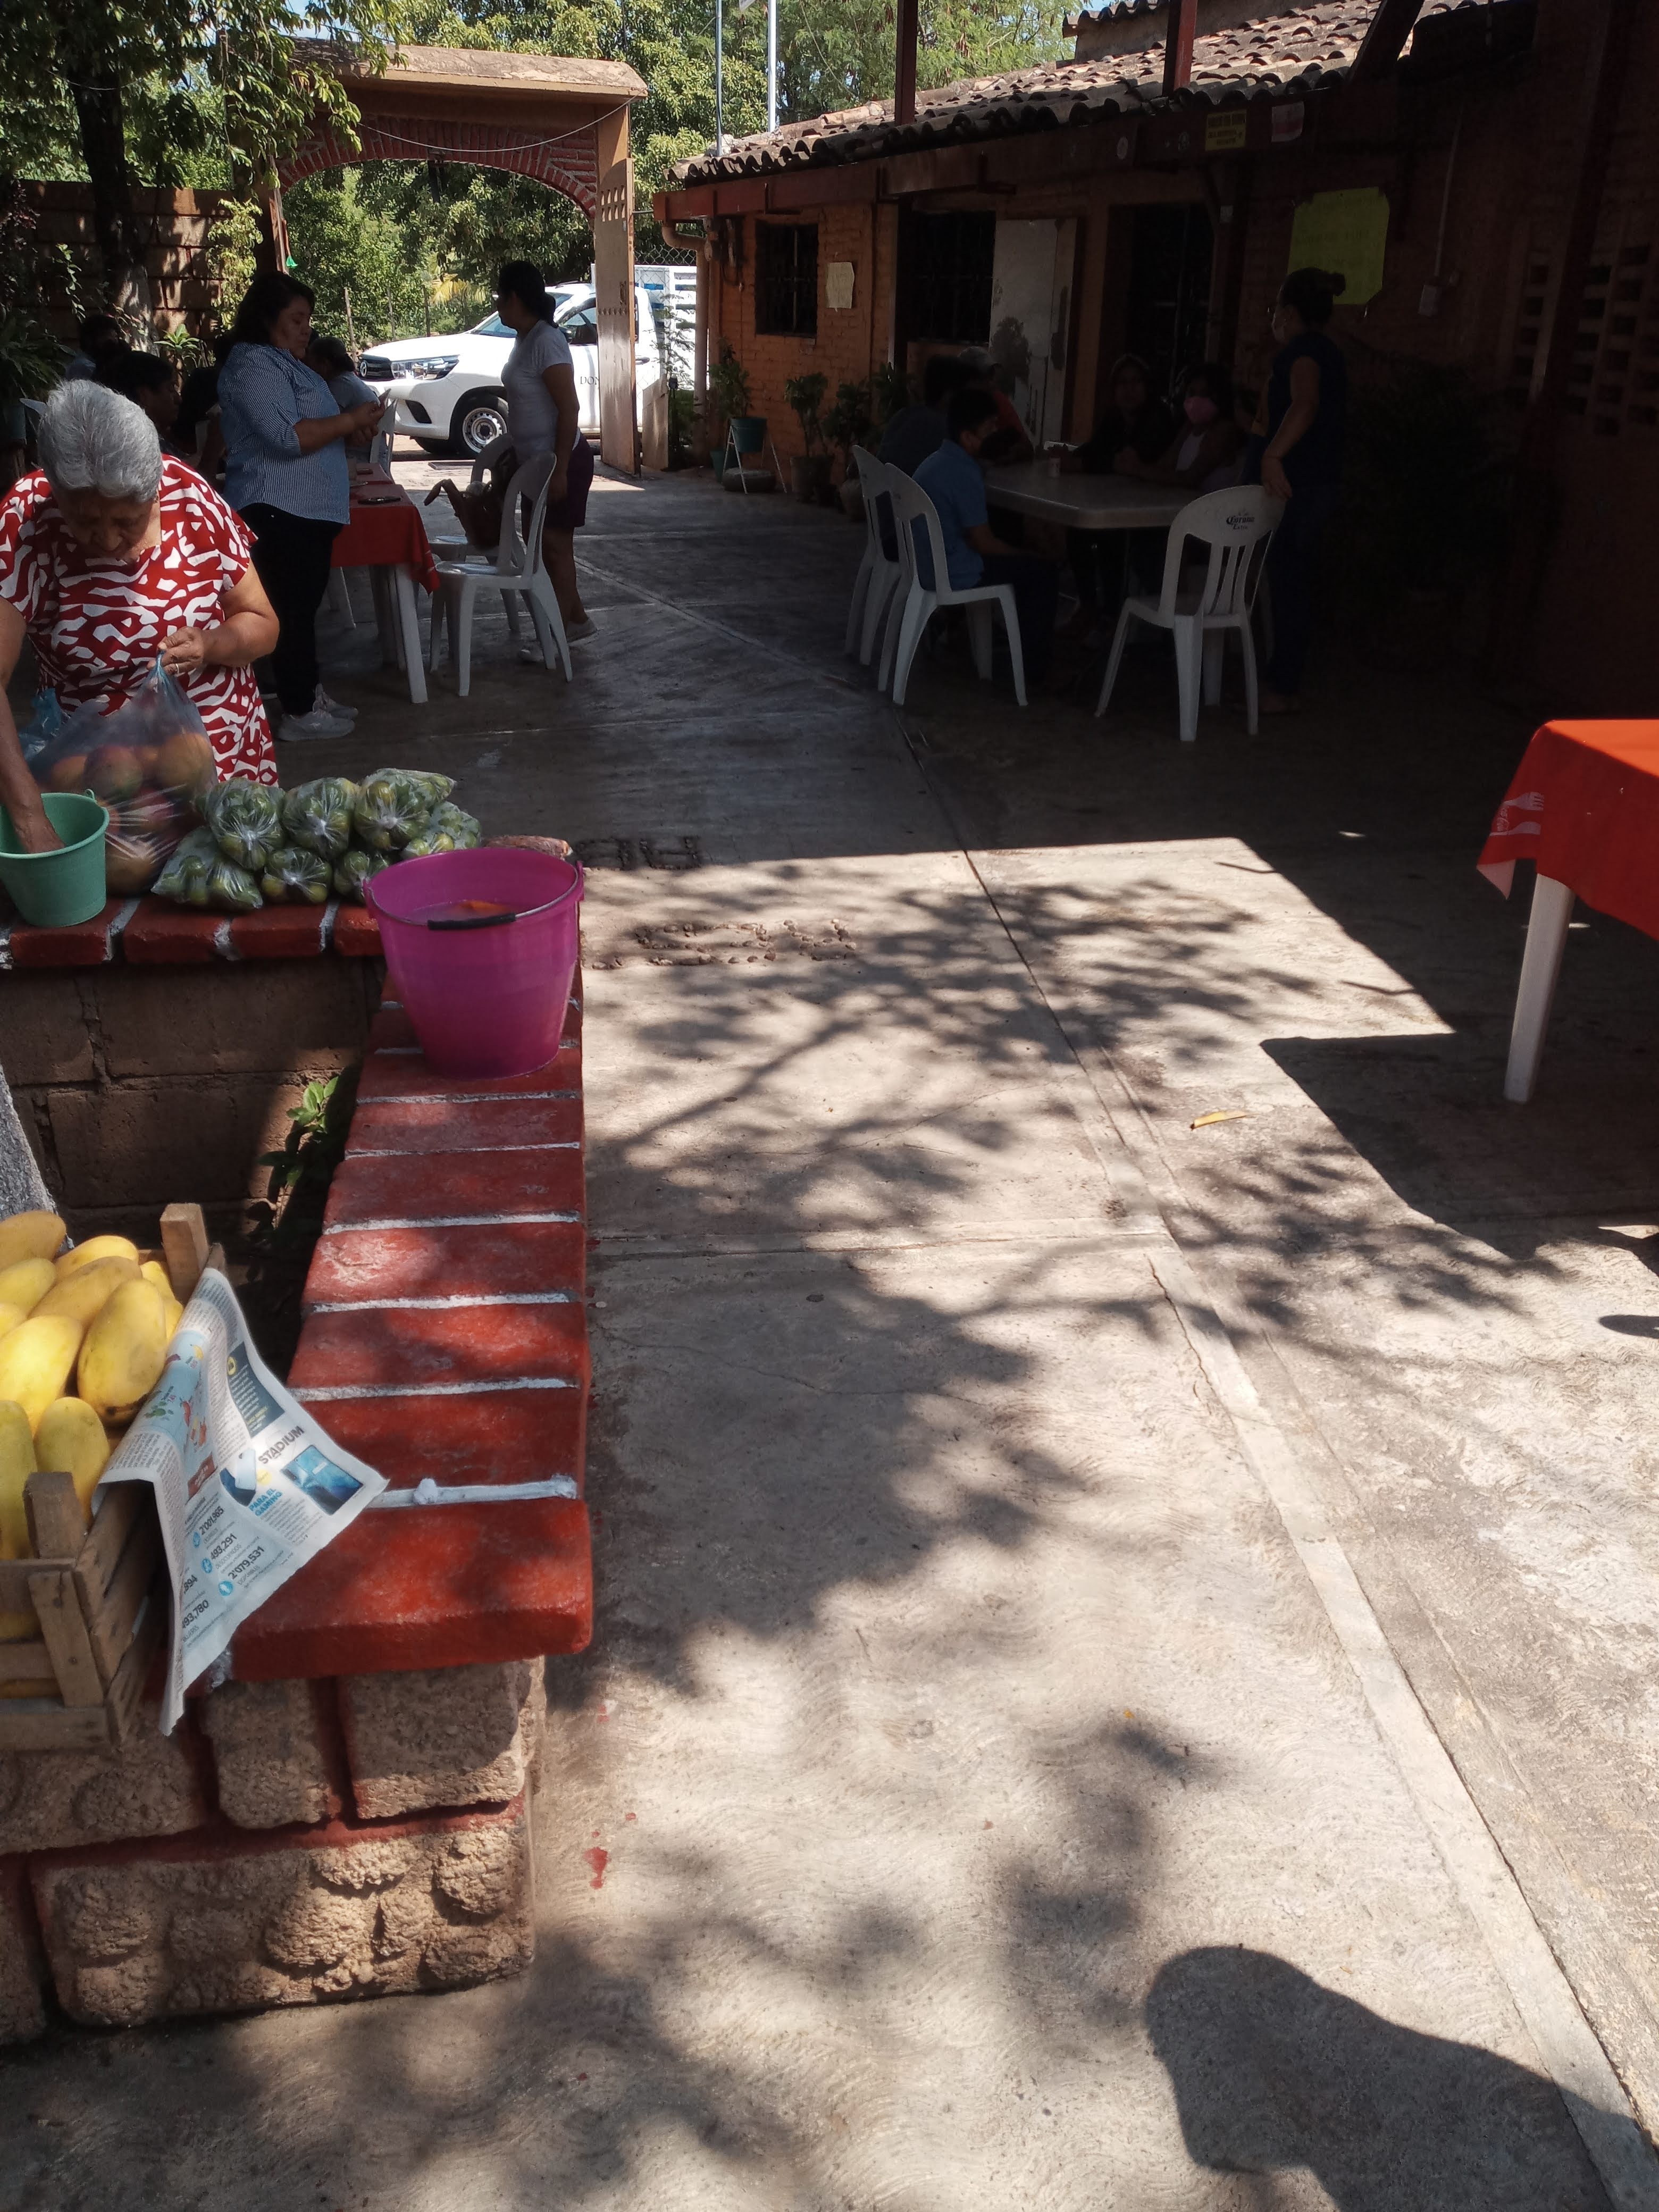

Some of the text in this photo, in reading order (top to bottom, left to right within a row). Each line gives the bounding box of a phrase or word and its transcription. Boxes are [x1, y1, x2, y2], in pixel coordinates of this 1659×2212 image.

[1226, 515, 1255, 525] Corona
[258, 1426, 305, 1464] STADIUM
[248, 1494, 269, 1511] PARA
[211, 1533, 237, 1560] 493,291
[228, 1546, 265, 1580] 2'079,531
